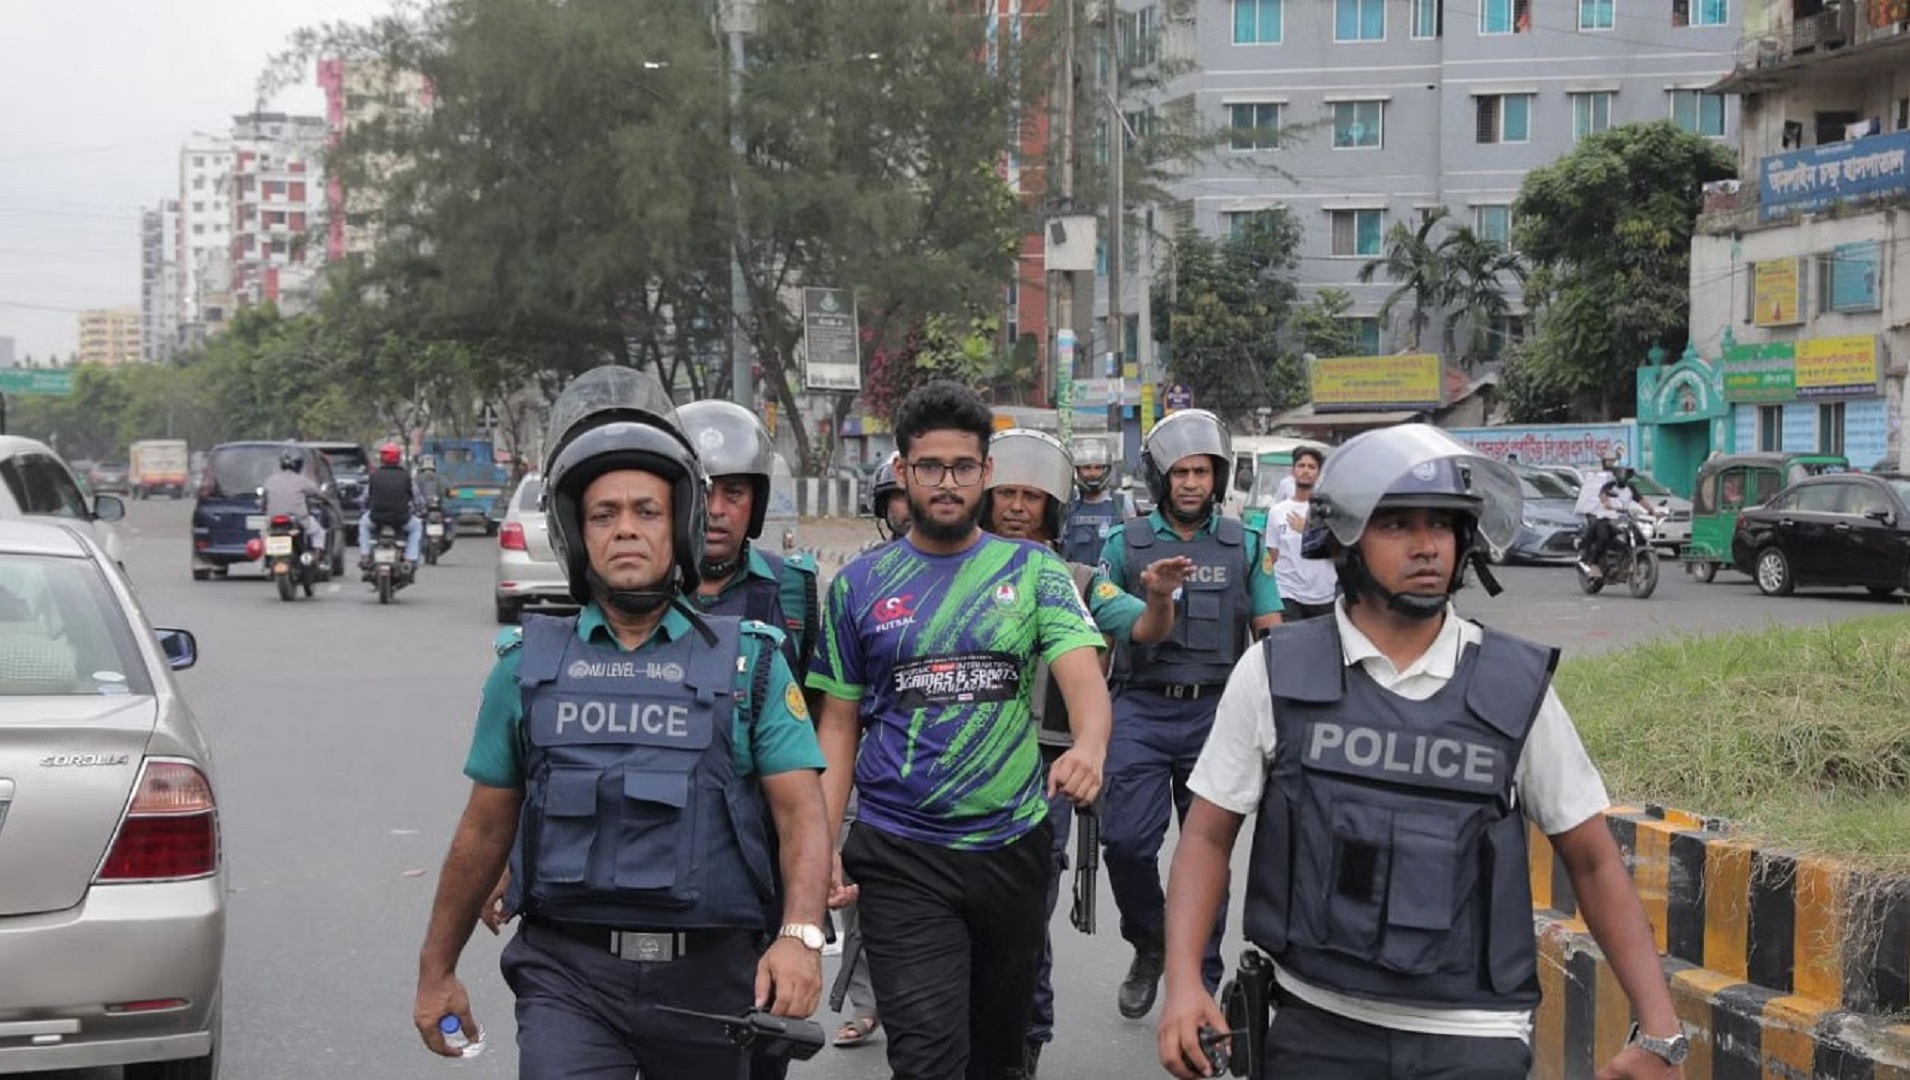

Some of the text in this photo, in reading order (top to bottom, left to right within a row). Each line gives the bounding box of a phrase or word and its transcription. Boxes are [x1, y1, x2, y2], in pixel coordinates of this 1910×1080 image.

[1185, 565, 1227, 583] ICE
[875, 615, 917, 633] FUTSAL
[904, 671, 955, 690] GAMES
[970, 668, 1019, 684] SPORTS
[555, 702, 689, 737] POLICE
[39, 754, 130, 768] COROLLA
[1310, 723, 1496, 783] POLICE
